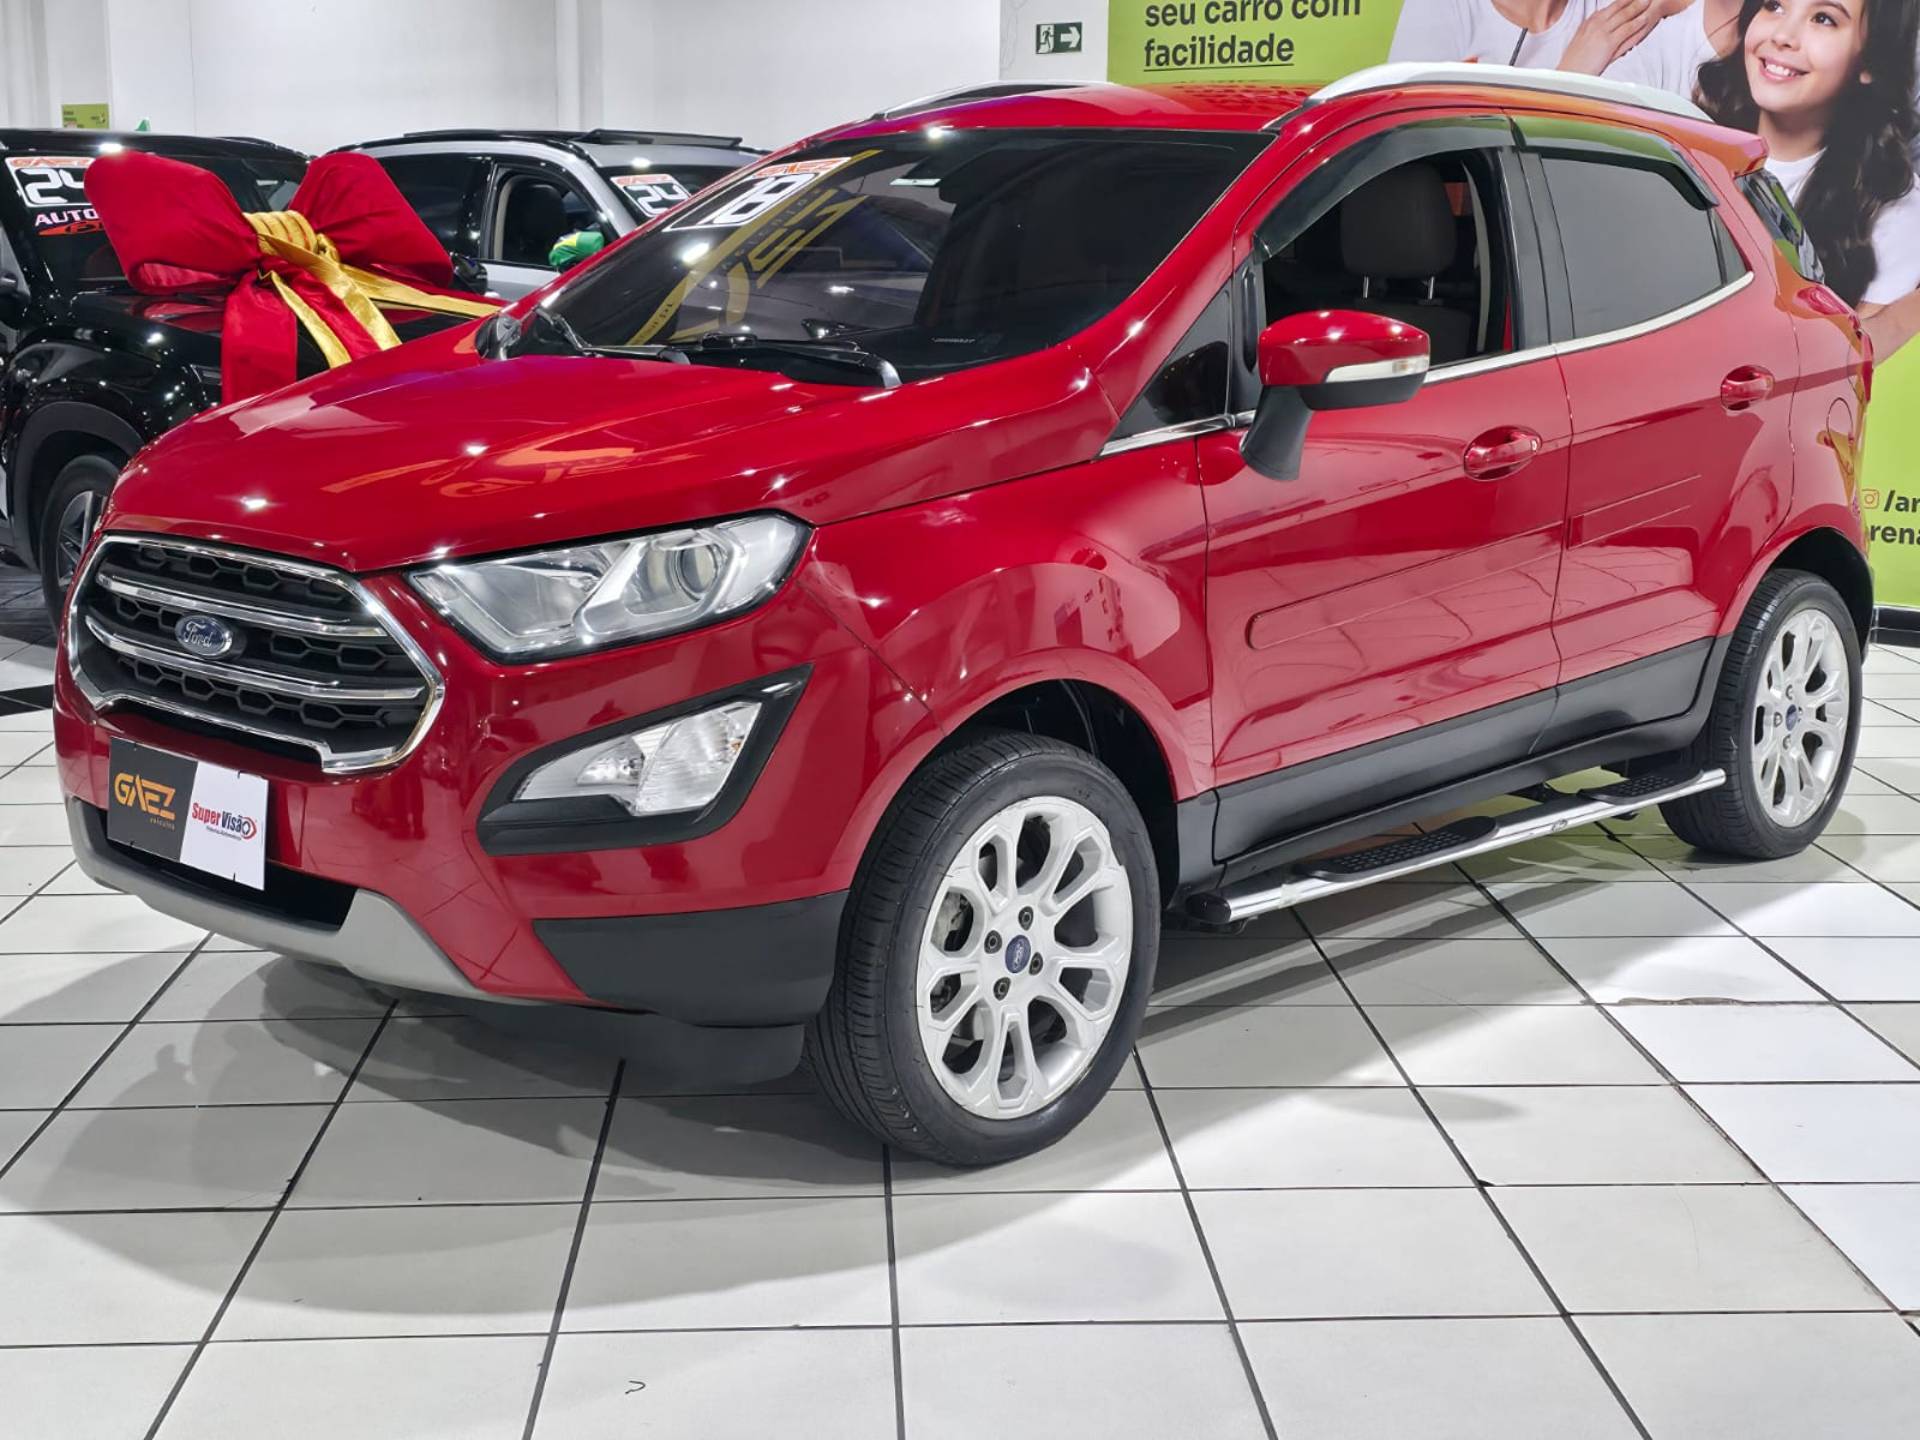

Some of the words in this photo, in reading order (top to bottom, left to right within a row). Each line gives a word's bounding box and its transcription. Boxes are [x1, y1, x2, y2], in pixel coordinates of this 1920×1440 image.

[1145, 3, 1195, 27] seu
[1204, 0, 1283, 24] carro
[1291, 0, 1361, 19] com
[1145, 33, 1294, 67] facilidade
[626, 184, 689, 214] 24
[35, 208, 99, 226] AUTO
[192, 802, 221, 825] Super
[221, 811, 251, 836] Visão
